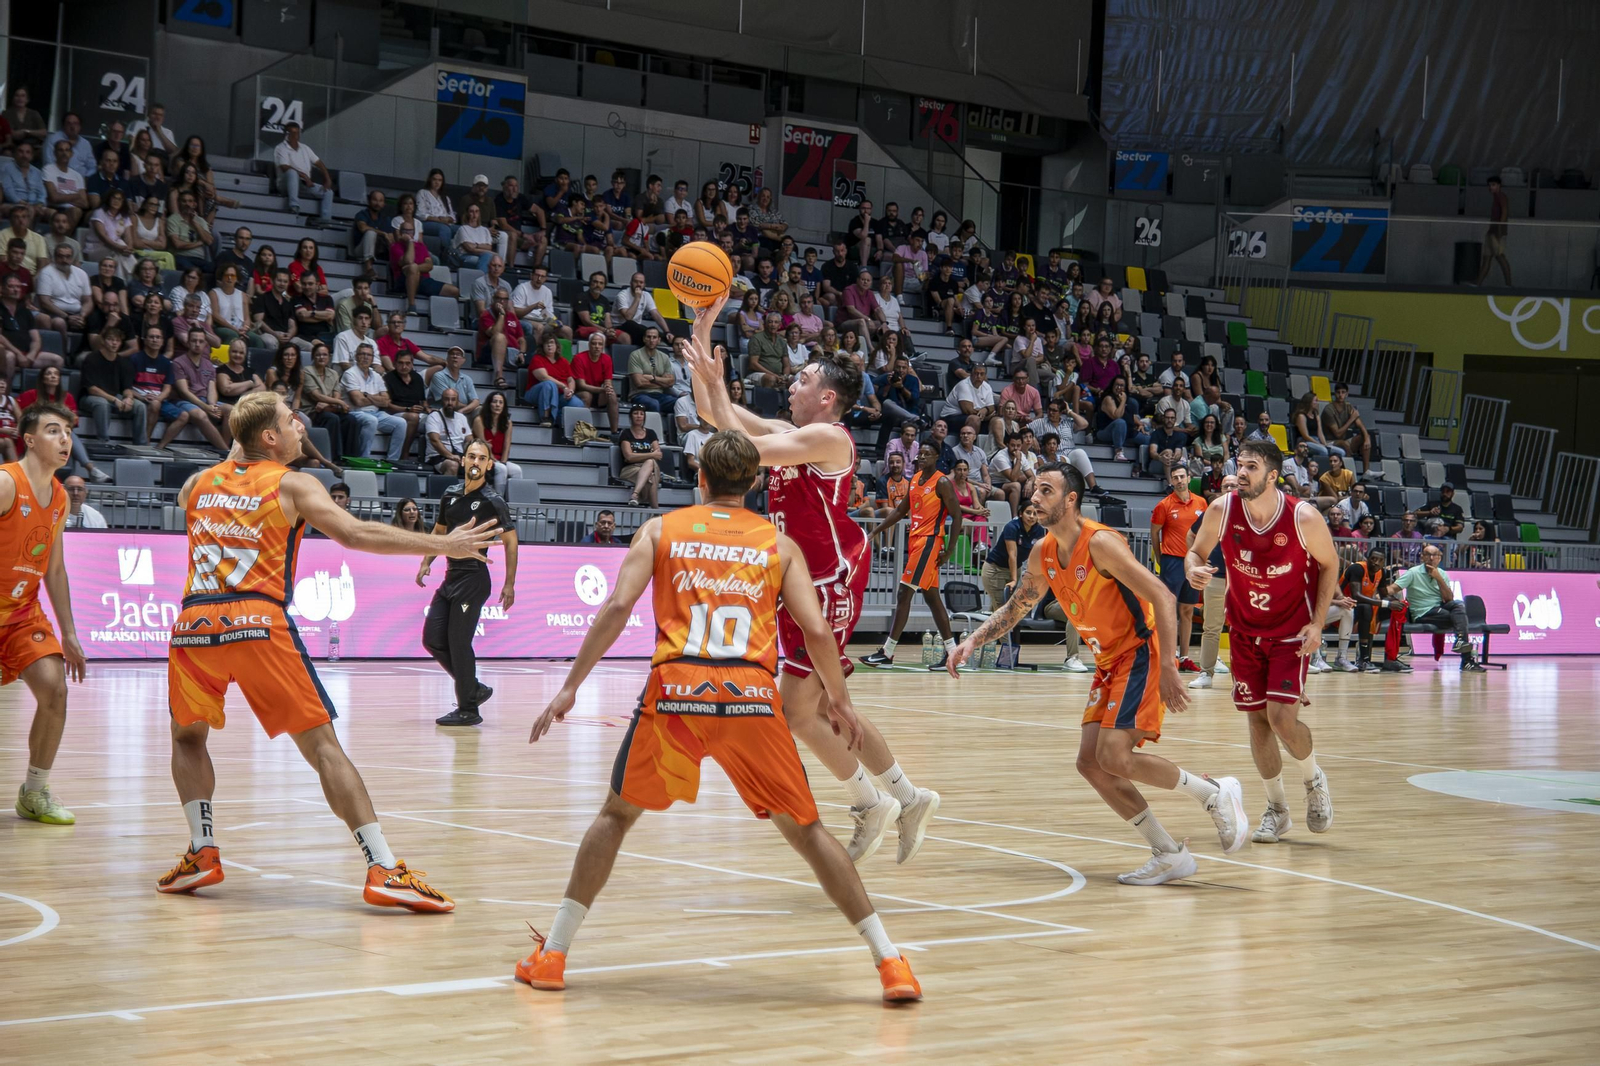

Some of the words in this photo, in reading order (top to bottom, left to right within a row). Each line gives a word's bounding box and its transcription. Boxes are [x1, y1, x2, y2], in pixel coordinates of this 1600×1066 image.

[100, 72, 146, 114] 24
[438, 71, 495, 98] Sector
[261, 96, 303, 133] 24
[436, 74, 525, 158] 25
[919, 98, 945, 111] Sector
[919, 102, 961, 142] 26
[784, 125, 832, 148] Sector
[1116, 151, 1152, 162] Sector
[718, 161, 753, 197] 25
[1116, 153, 1170, 190] 27
[834, 195, 858, 207] Sector
[835, 177, 867, 205] 25
[1293, 206, 1353, 224] Sector
[1135, 216, 1162, 247] 26
[1228, 230, 1267, 259] 26
[1291, 208, 1388, 273] 27
[672, 269, 713, 293] Wilson
[196, 493, 262, 511] BURGOS
[191, 515, 262, 541] Wheyland
[190, 544, 260, 592] 27
[670, 541, 768, 568] HERRERA
[672, 568, 765, 601] Wheyland
[101, 591, 179, 629] Jaén
[1248, 590, 1270, 611] 22
[546, 613, 584, 628] PABLO
[682, 603, 752, 658] 10
[90, 628, 141, 643] PARAÍSO
